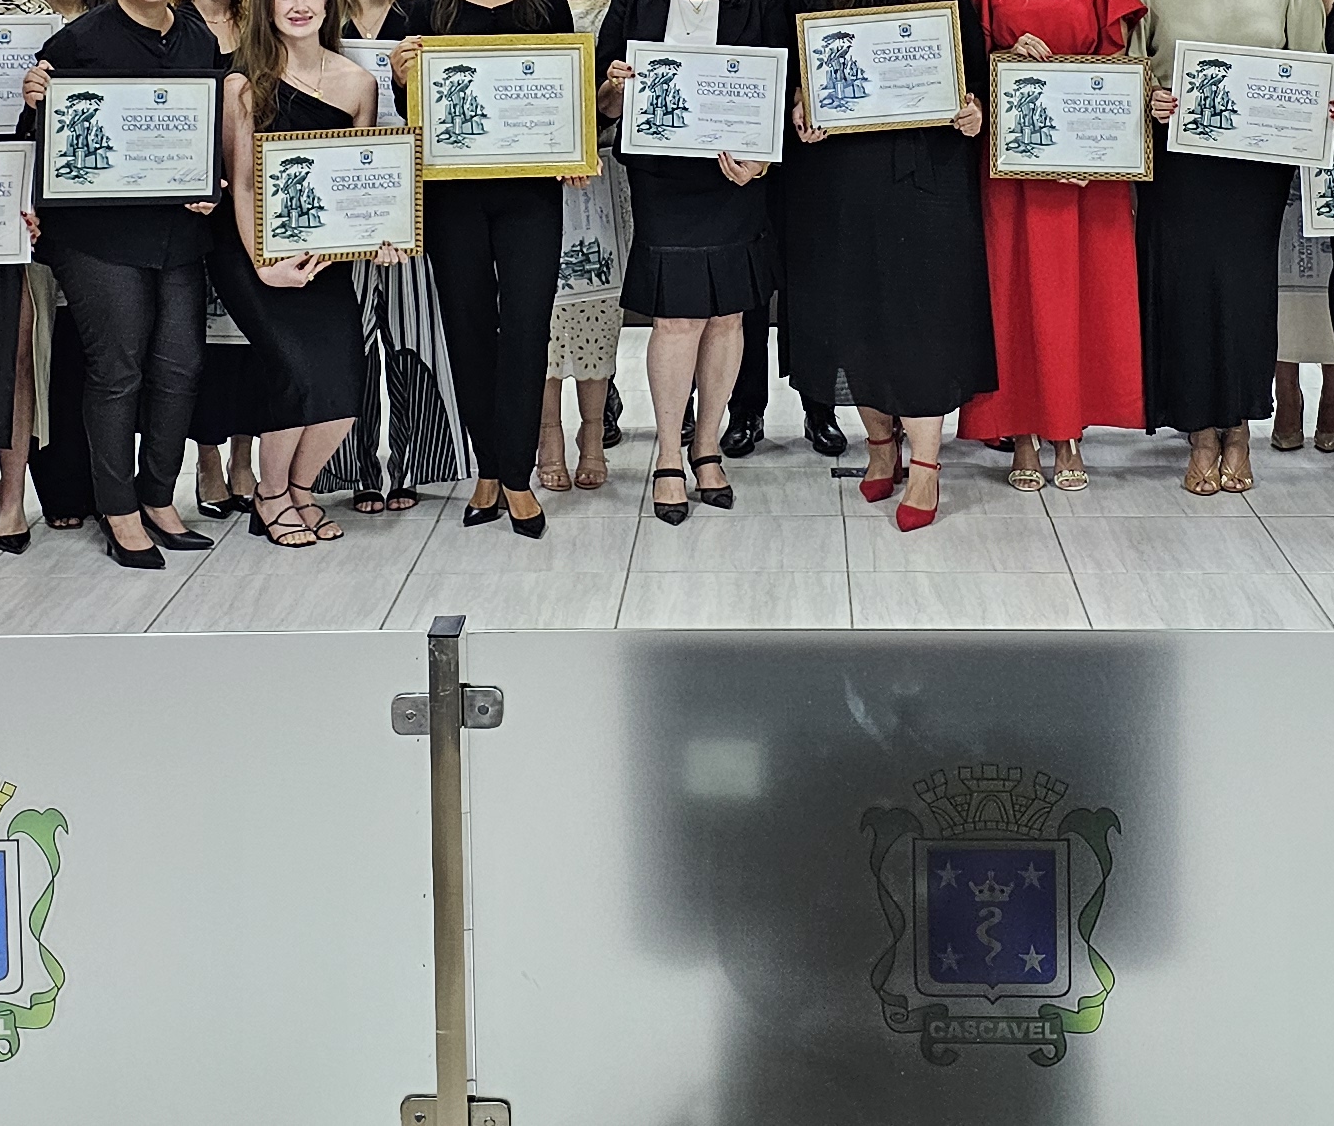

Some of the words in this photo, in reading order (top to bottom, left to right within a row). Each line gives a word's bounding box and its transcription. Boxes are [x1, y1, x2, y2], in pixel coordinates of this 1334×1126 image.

[872, 47, 891, 56] VOTO
[905, 46, 934, 54] LOUVOR
[873, 52, 942, 64] CONGRATULAÇÕES
[527, 84, 556, 92] LOUVOR
[697, 80, 716, 88] VOTO
[718, 81, 728, 89] DE
[730, 82, 760, 90] LOUVOR
[1247, 84, 1266, 92] VOTO
[1268, 85, 1279, 93] DE
[1280, 87, 1312, 96] LOUVOR
[493, 92, 563, 101] CONGRATULAÇÕES
[697, 89, 766, 99] CONGRATULAÇÕES
[1246, 91, 1318, 105] CONGRATULAÇÕES
[1062, 98, 1081, 106] VOTO
[1095, 99, 1124, 107] LOUVOR
[1062, 107, 1131, 116] CONGRATULAÇÕES
[121, 114, 143, 123] VOTO
[144, 114, 155, 123] DE
[157, 114, 191, 123] LOUVOR
[193, 114, 199, 123] E
[122, 123, 197, 133] CONGRATULAÇÕES
[331, 175, 350, 183] VOTO
[352, 174, 362, 182] DE
[364, 173, 395, 182] LOUVOR
[331, 181, 401, 192] CONGRATULAÇÕES
[929, 1021, 1058, 1039] CASCAVEL
